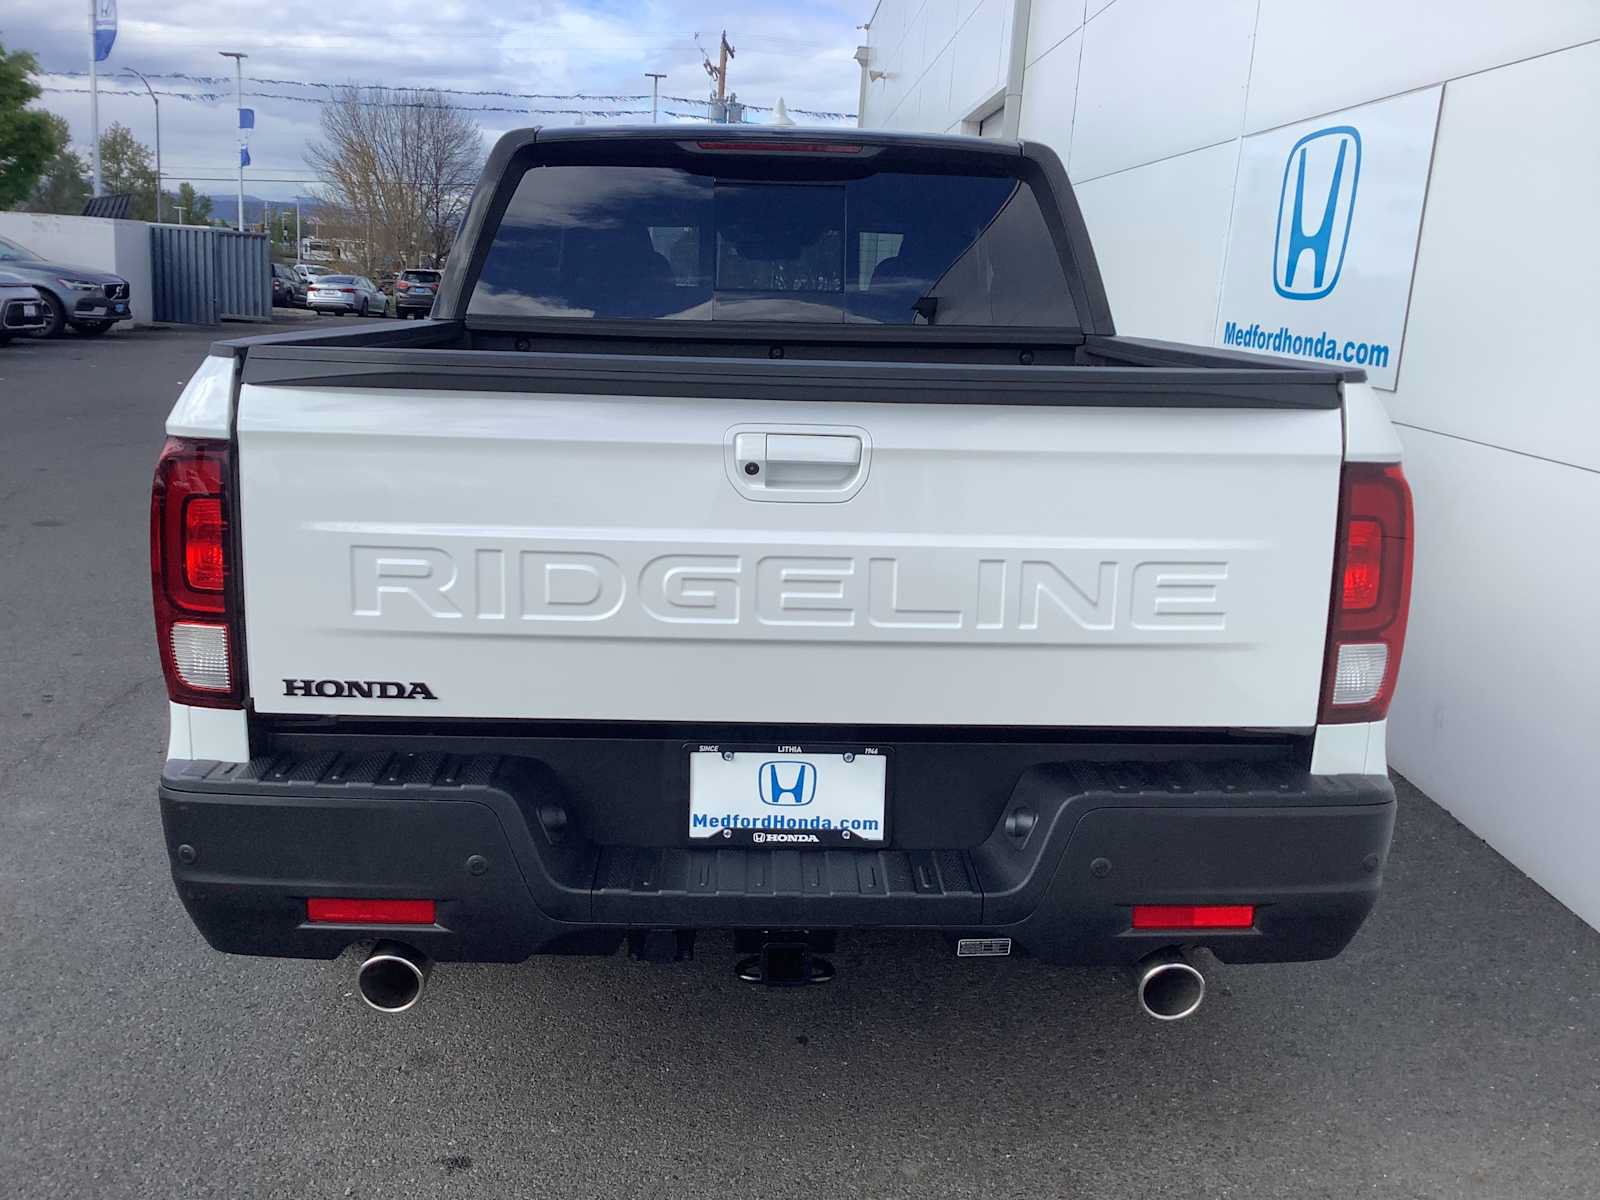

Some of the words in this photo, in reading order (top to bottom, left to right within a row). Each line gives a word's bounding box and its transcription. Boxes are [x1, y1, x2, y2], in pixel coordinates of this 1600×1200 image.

[1223, 321, 1389, 367] Medfordhonda.com
[349, 544, 1228, 631] RIDGELINE
[282, 679, 438, 699] HONDA
[777, 745, 803, 753] LITHIA
[692, 814, 879, 830] MedfordHonda.com
[766, 833, 819, 843] HONDA
